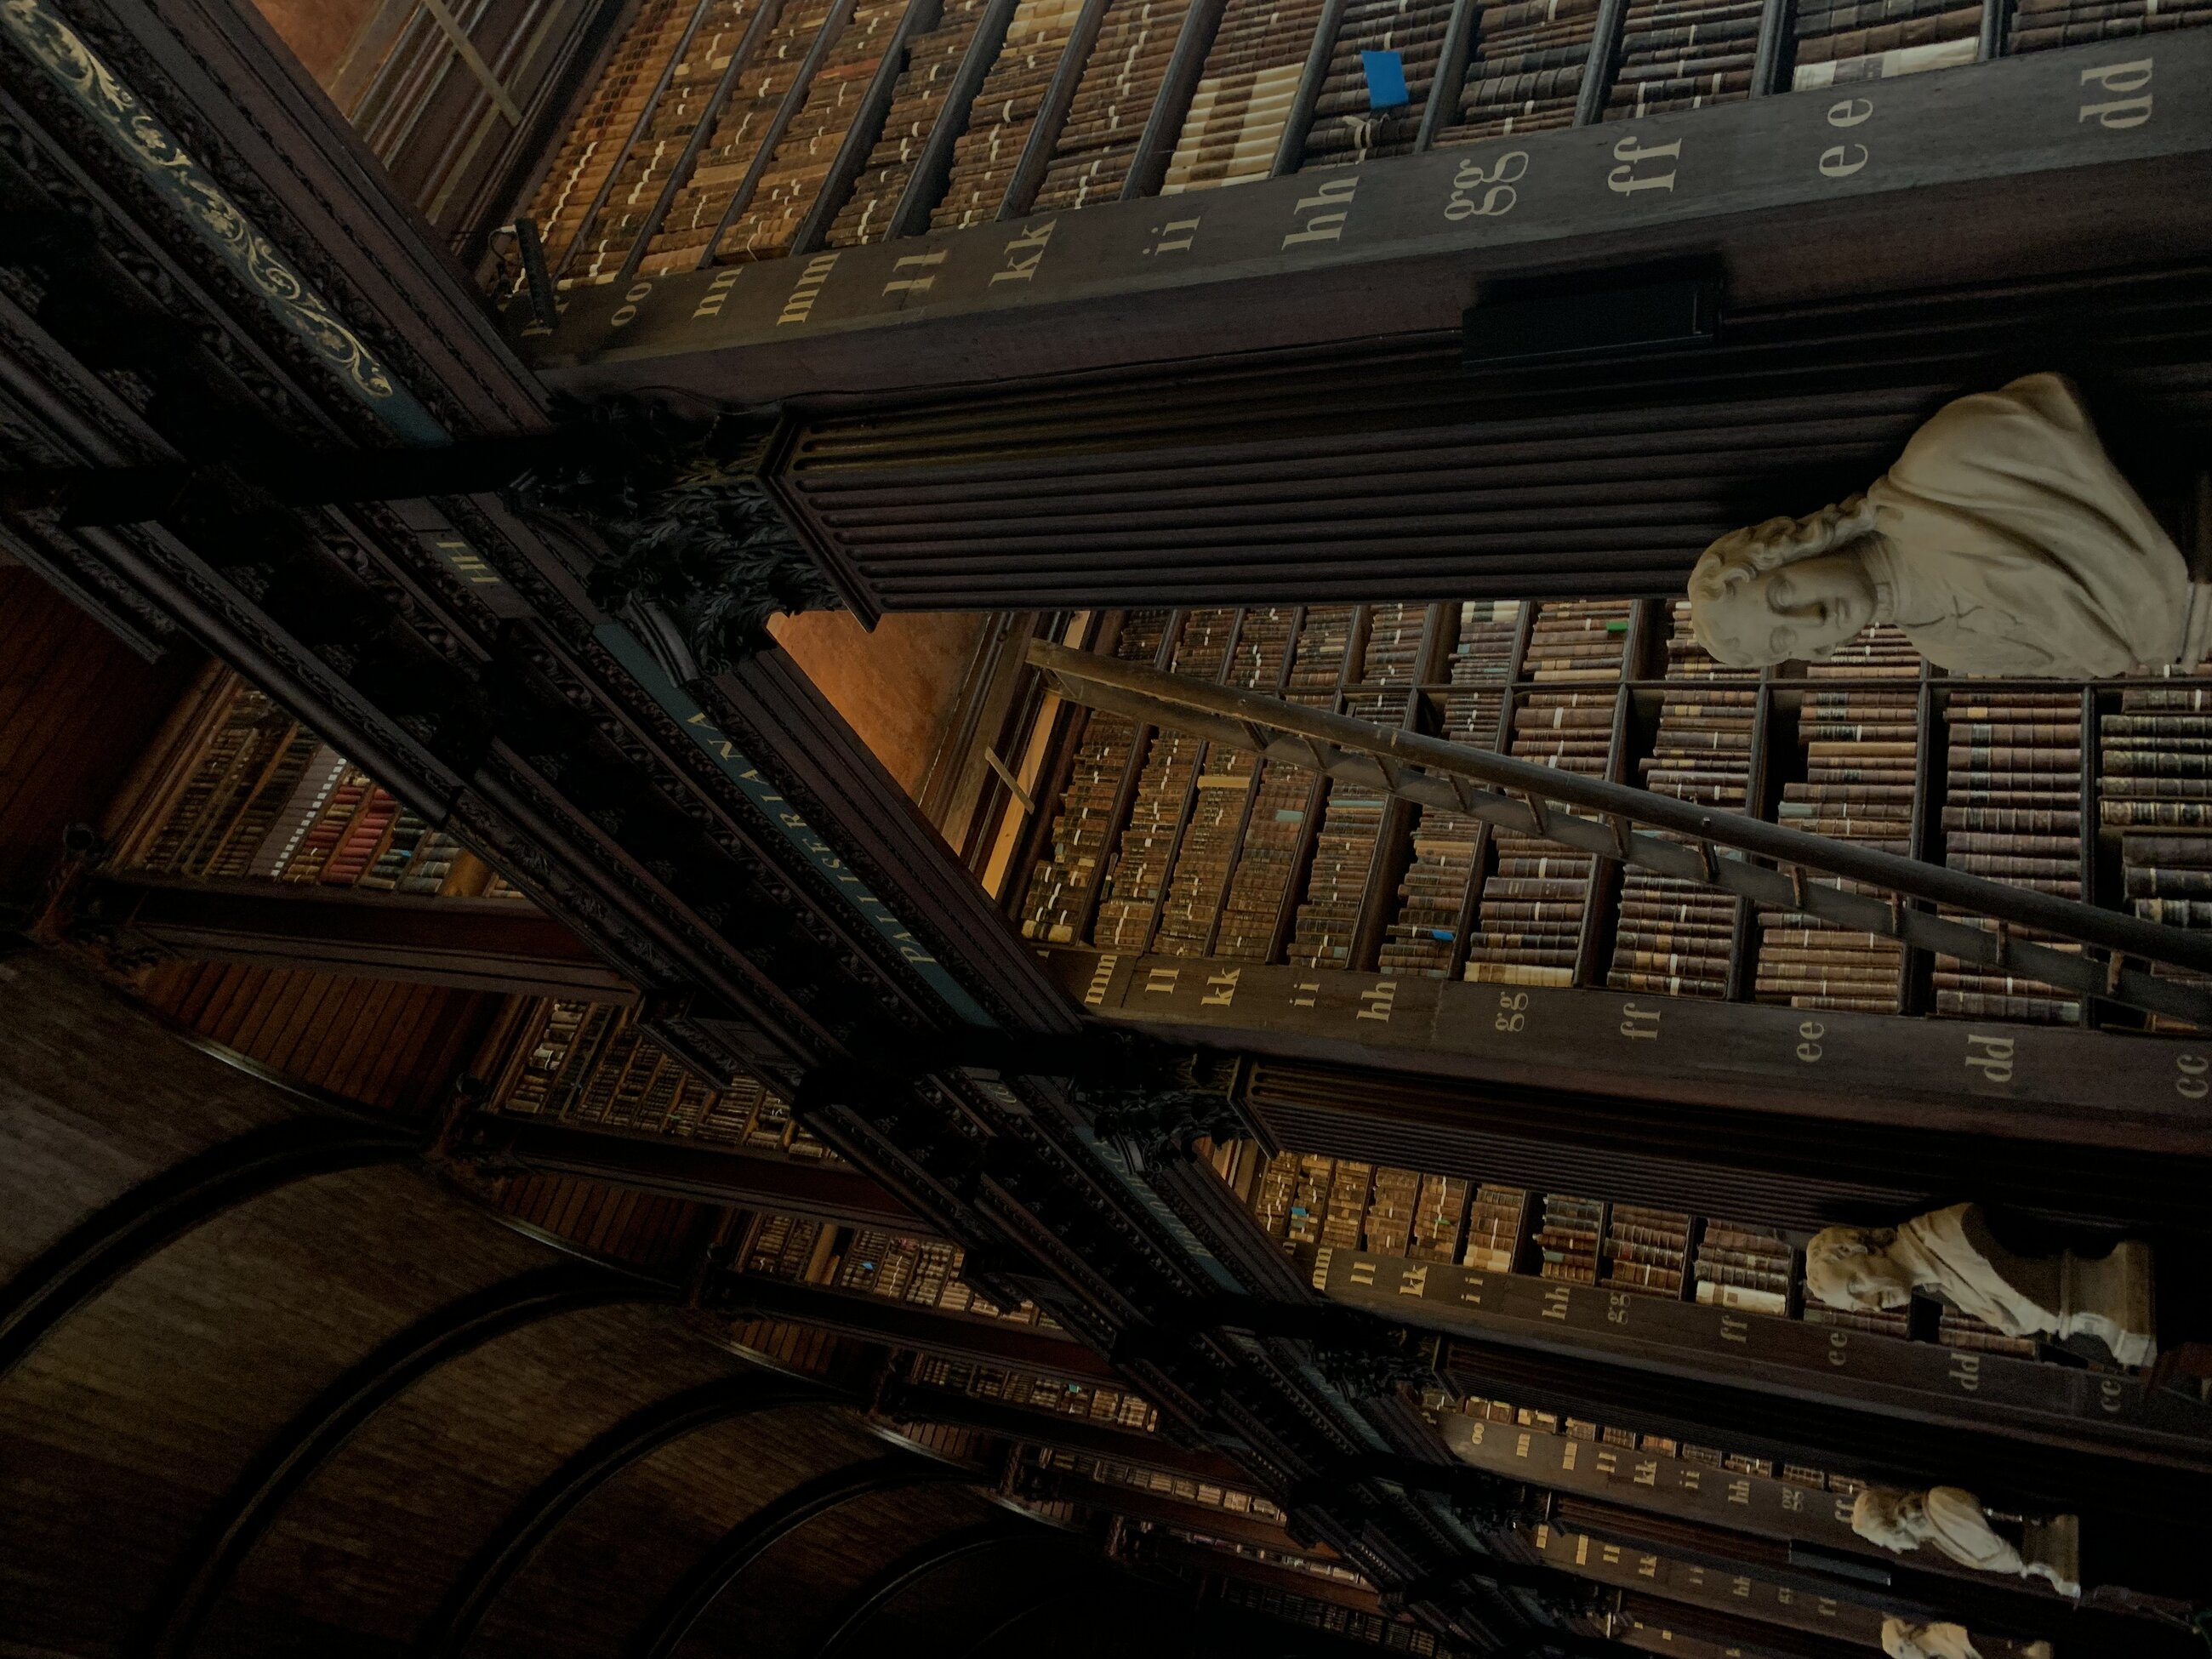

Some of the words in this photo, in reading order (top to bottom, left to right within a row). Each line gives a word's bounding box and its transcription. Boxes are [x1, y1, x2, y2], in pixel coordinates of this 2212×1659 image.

[2079, 58, 2152, 128] dd
[1819, 99, 1873, 177] ee
[1445, 151, 1529, 220] gg
[1608, 136, 1681, 196] ff
[1282, 176, 1359, 249] hh
[989, 219, 1057, 286] kk
[1143, 217, 1200, 255] ii
[693, 264, 743, 317] nn
[777, 253, 840, 326] mm
[882, 250, 947, 296] ll
[611, 282, 653, 326] oo
[1085, 955, 1117, 1005] mm
[1145, 969, 1179, 994] ll
[1201, 968, 1240, 1006] kk
[1290, 983, 1320, 1006] ii
[1357, 982, 1396, 1022] hh
[1495, 991, 1528, 1031] gg
[1621, 1002, 1660, 1038] ff
[1797, 1021, 1825, 1061] ee
[1965, 1034, 2014, 1081] dd
[2176, 1055, 2208, 1098] cc
[1313, 1248, 1332, 1291] mm
[1350, 1263, 1376, 1285] ll
[1400, 1265, 1428, 1297] kk
[1461, 1278, 1483, 1303] ii
[1542, 1287, 1570, 1320] hh
[1608, 1291, 1630, 1324] gg
[1720, 1315, 1747, 1343] ff
[1949, 1352, 1979, 1390] dd
[1472, 1423, 1484, 1445] oo
